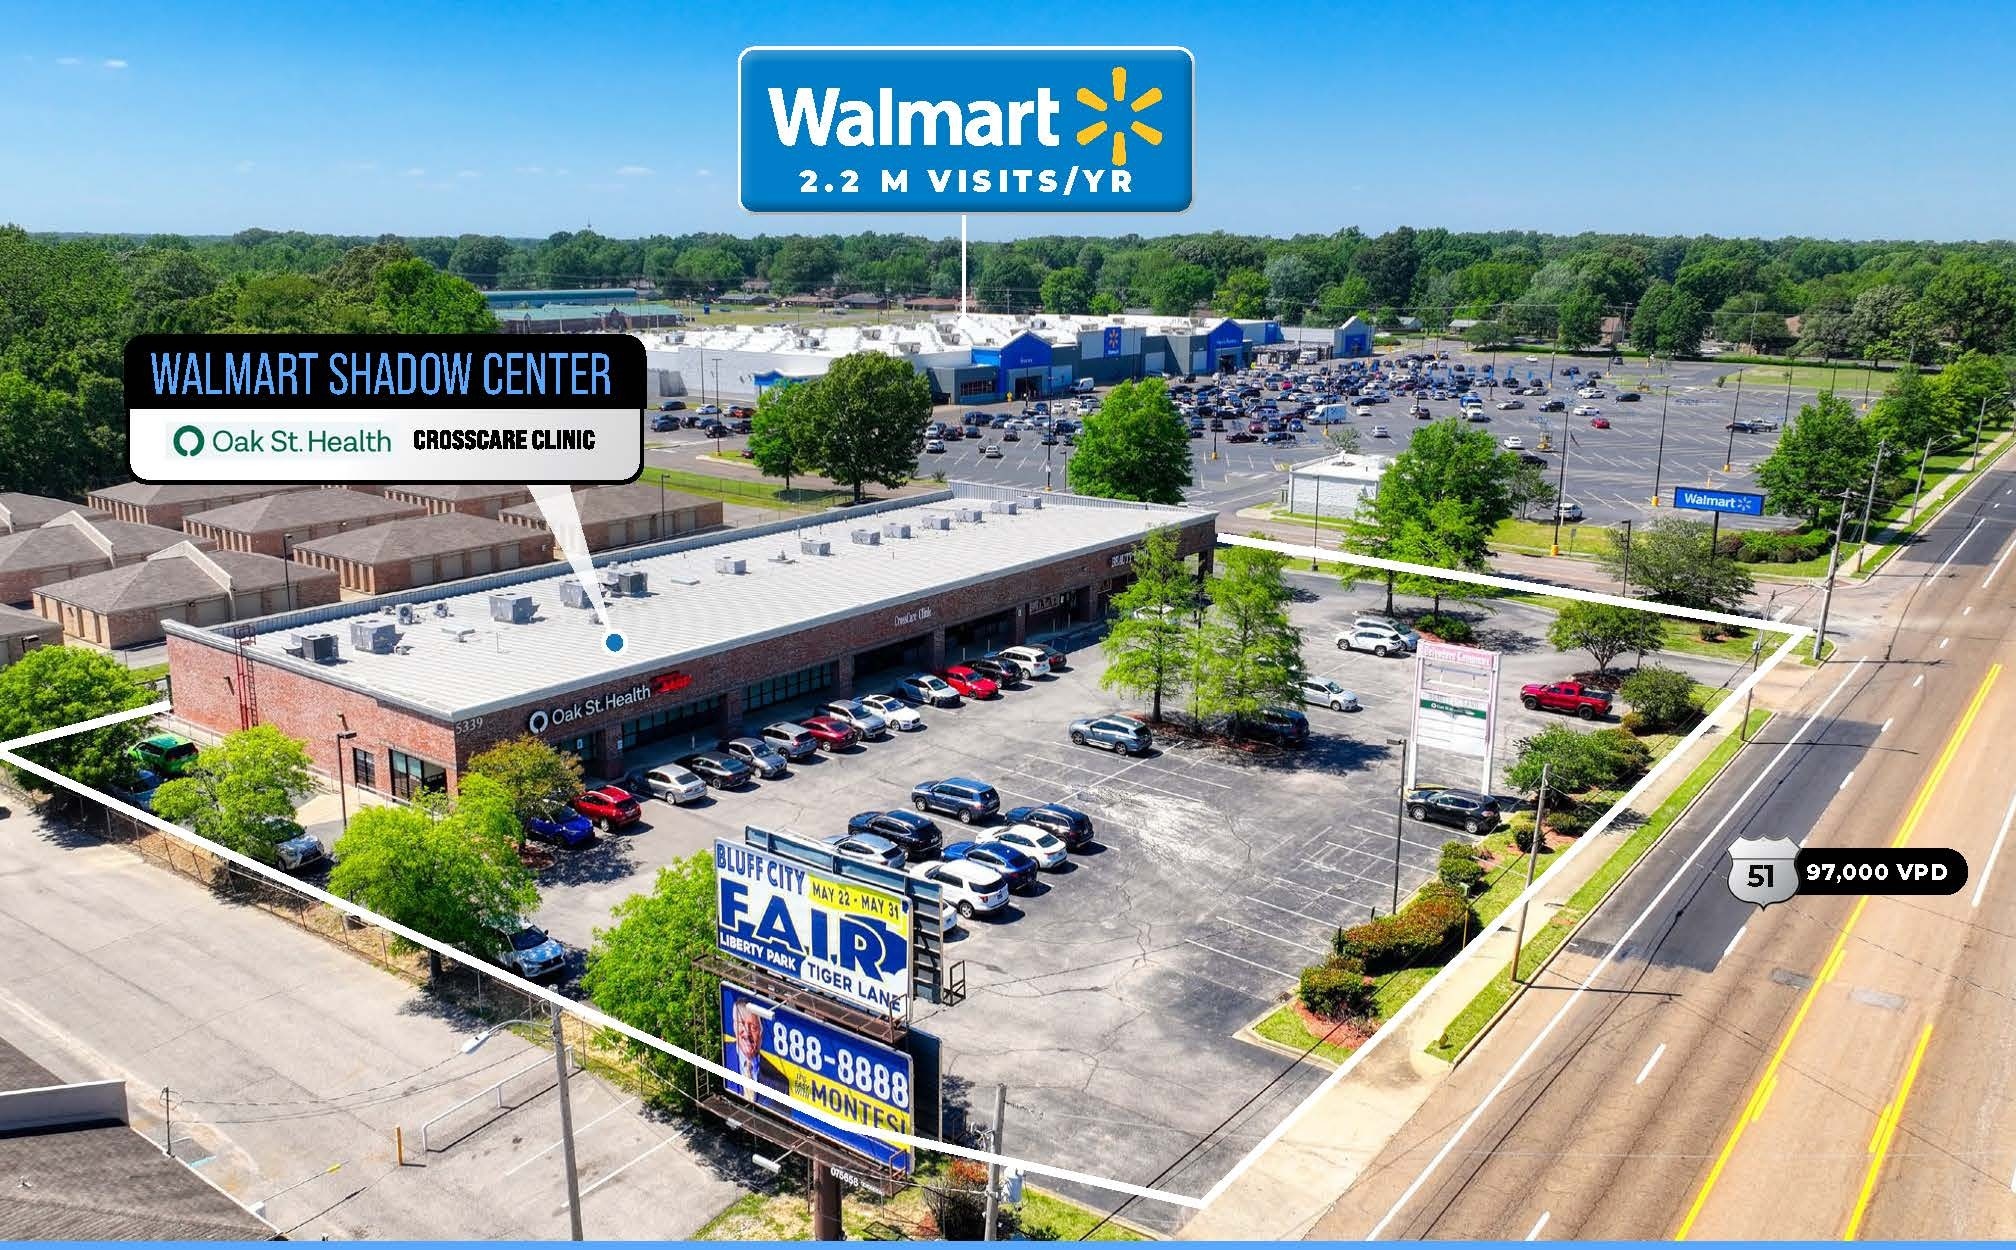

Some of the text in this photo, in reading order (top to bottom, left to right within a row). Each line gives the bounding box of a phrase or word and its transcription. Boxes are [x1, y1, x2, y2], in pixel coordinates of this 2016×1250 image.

[1684, 492, 1736, 508] Walmart
[455, 716, 484, 735] 5339
[552, 684, 651, 726] Oak St. Health
[716, 842, 806, 896] BLUFF CITY
[812, 881, 835, 902] MAY
[839, 890, 851, 907] 22
[861, 895, 884, 915] MAY
[888, 903, 900, 921] 31
[719, 930, 798, 972] LIBERTY PARK
[807, 961, 901, 1014] TIGER LANE
[773, 1022, 909, 1109] 888-8888
